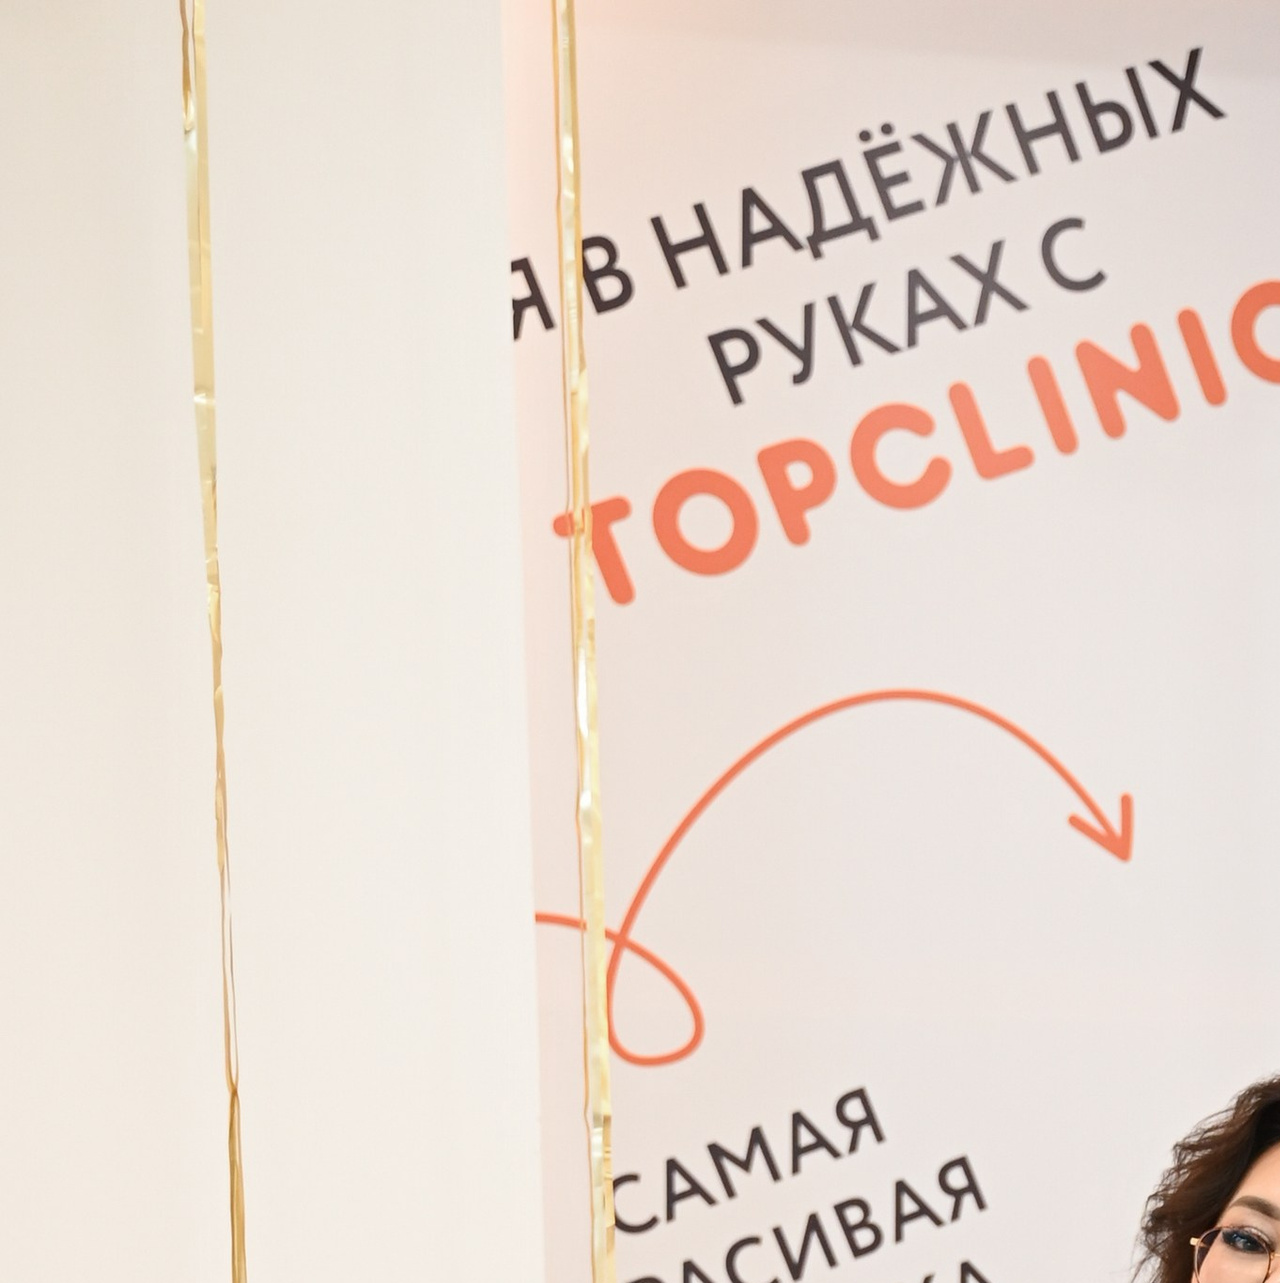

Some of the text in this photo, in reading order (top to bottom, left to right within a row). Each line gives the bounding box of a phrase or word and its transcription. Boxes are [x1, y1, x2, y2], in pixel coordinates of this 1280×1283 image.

[580, 235, 635, 315] В
[649, 46, 1227, 290] НАДЁЖНЫХ
[705, 216, 1107, 406] РУКАХ С
[611, 1086, 886, 1235] САМАЯ
